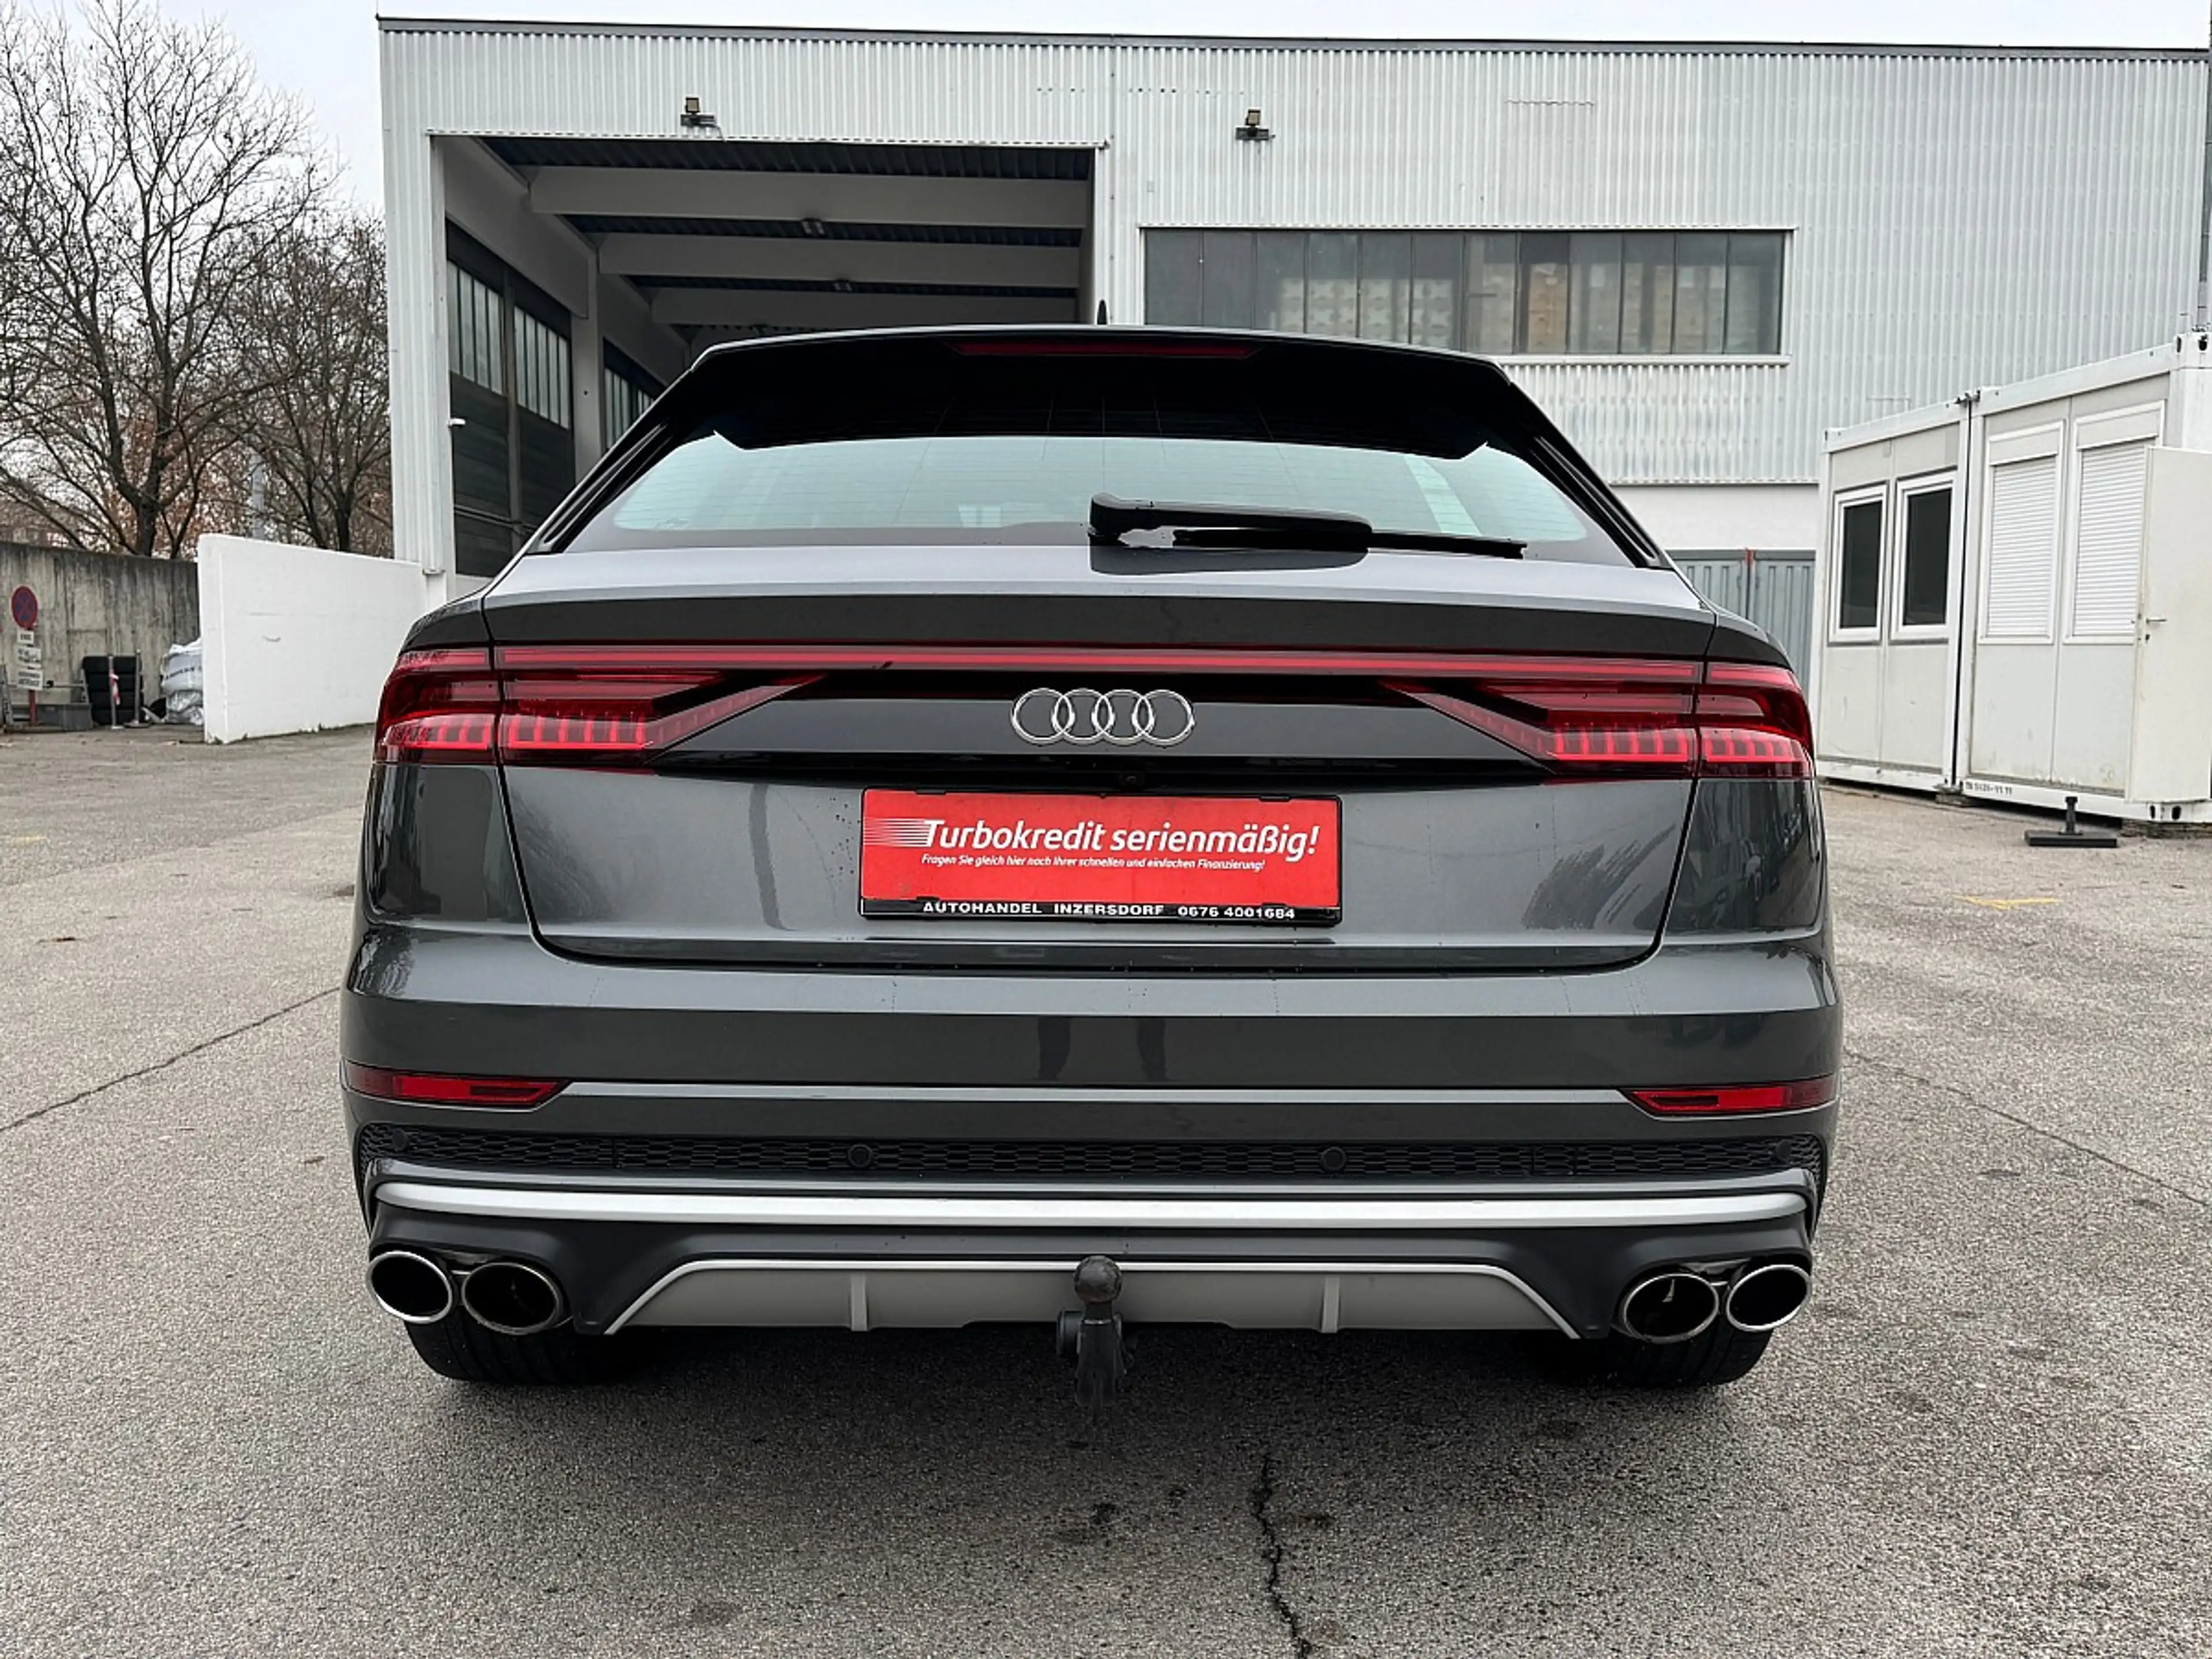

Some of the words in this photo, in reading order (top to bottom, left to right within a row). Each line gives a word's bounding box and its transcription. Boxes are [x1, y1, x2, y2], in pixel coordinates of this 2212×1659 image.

[923, 819, 1106, 850] Turbokredit
[1109, 821, 1320, 862] serienmäßig!
[922, 853, 957, 867] Fragen
[959, 855, 974, 865] Sie
[975, 855, 1005, 867] gleich
[1006, 855, 1026, 865] hier
[1053, 856, 1077, 867] Ihrer
[1078, 857, 1125, 867] schnellen
[1126, 858, 1146, 868] und
[1147, 857, 1195, 869] einfachen
[1197, 858, 1266, 872] Finanzierung!
[923, 902, 1043, 914] AUTOHANDEL
[1054, 903, 1164, 916] INZERSDORF
[1177, 906, 1219, 918] 0676
[1223, 906, 1296, 919] 4001684
